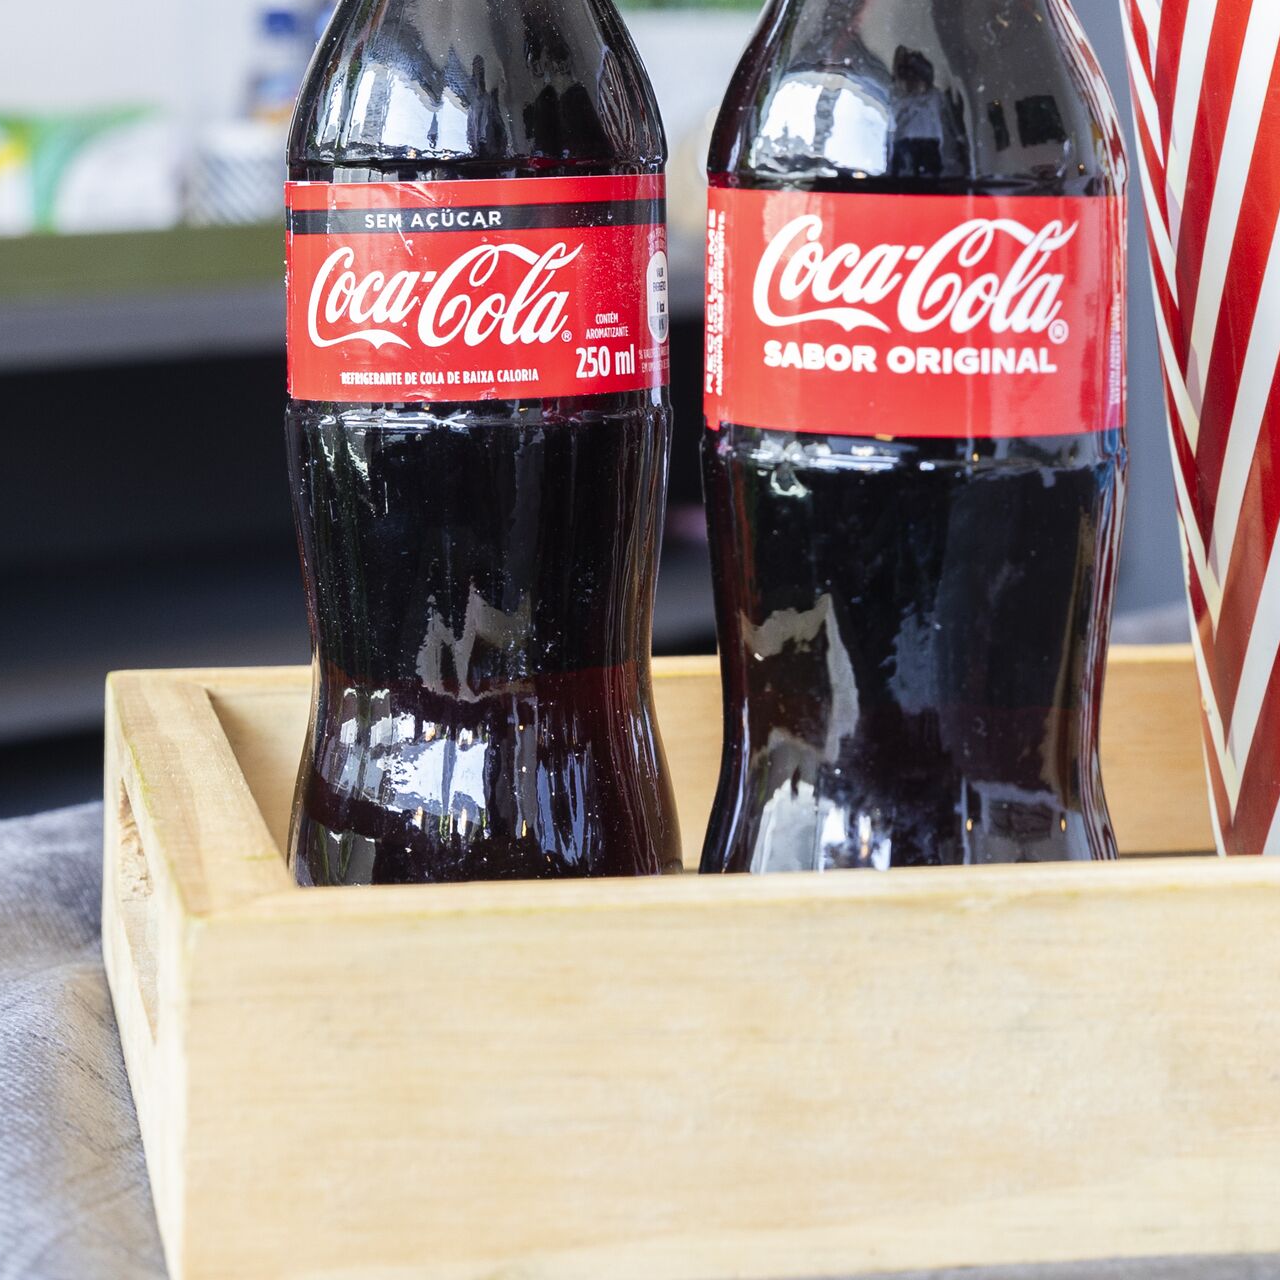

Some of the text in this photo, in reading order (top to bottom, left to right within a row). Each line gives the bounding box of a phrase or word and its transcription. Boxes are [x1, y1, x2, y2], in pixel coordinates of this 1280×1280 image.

[364, 213, 403, 228] SEM
[752, 214, 1080, 334] Coca-Cola
[307, 242, 584, 350] Coca-Cola
[575, 345, 611, 379] 250
[614, 343, 636, 376] ml
[763, 339, 1057, 375] SABOR ORIGINAL
[341, 368, 539, 385] REFRIGERANTE DE COLA DE BAIXA CALORIA
